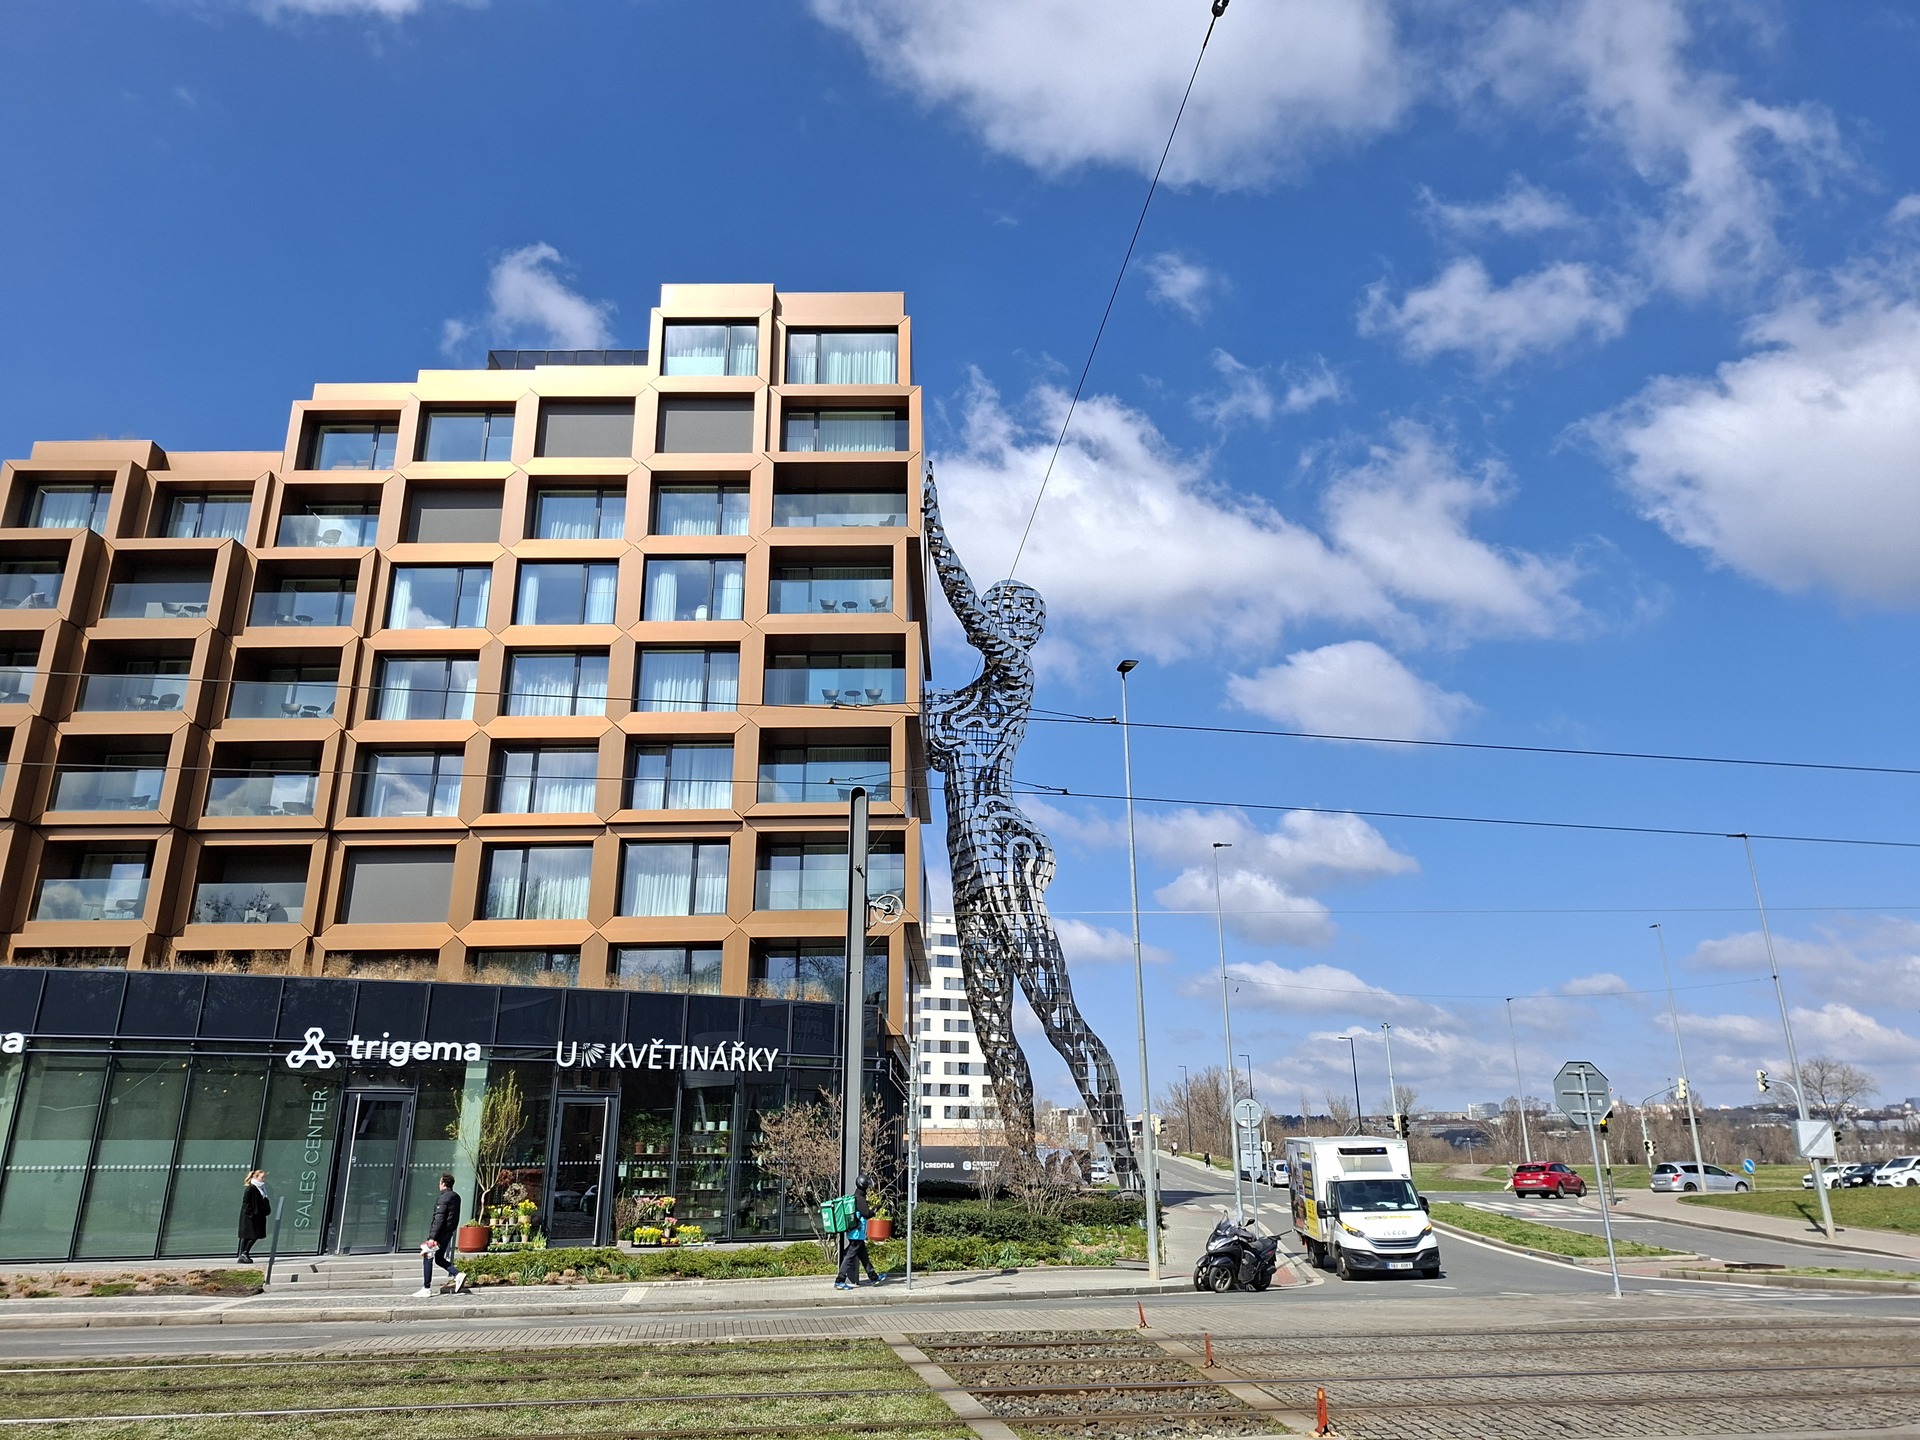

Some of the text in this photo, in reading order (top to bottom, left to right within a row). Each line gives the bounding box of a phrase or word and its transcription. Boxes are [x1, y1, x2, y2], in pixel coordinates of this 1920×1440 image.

[347, 1032, 481, 1067] trigema
[556, 1038, 779, 1072] U KVĚTINÁŘKY
[294, 1090, 329, 1228] SALES CENTER
